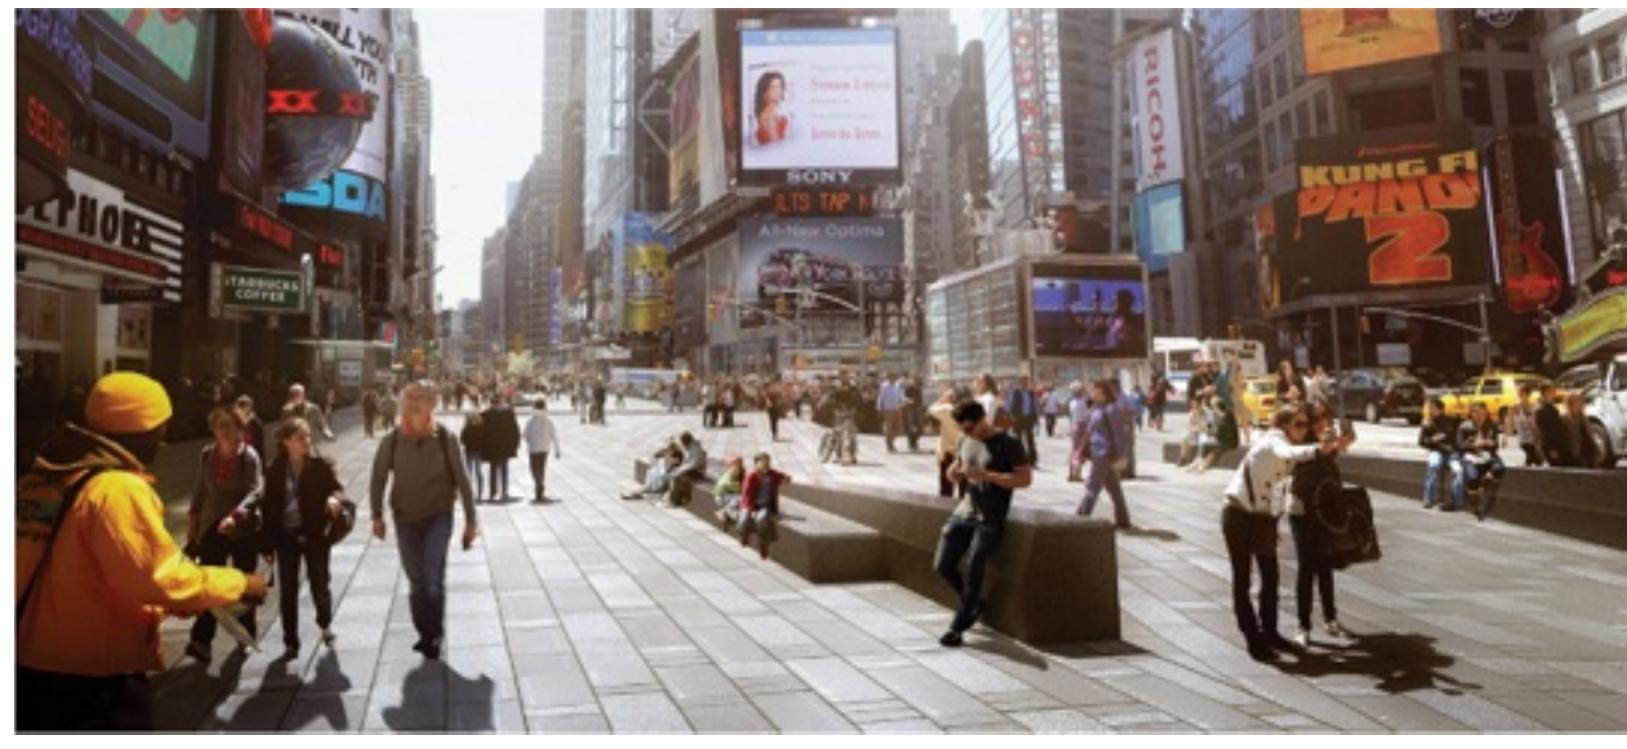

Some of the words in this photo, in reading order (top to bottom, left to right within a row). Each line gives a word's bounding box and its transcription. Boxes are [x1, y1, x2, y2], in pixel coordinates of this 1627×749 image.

[786, 171, 852, 185] SONY
[1301, 159, 1426, 188] KUNG
[825, 223, 885, 239] Optima
[1364, 211, 1452, 284] 2
[235, 288, 285, 302] COFFEE
